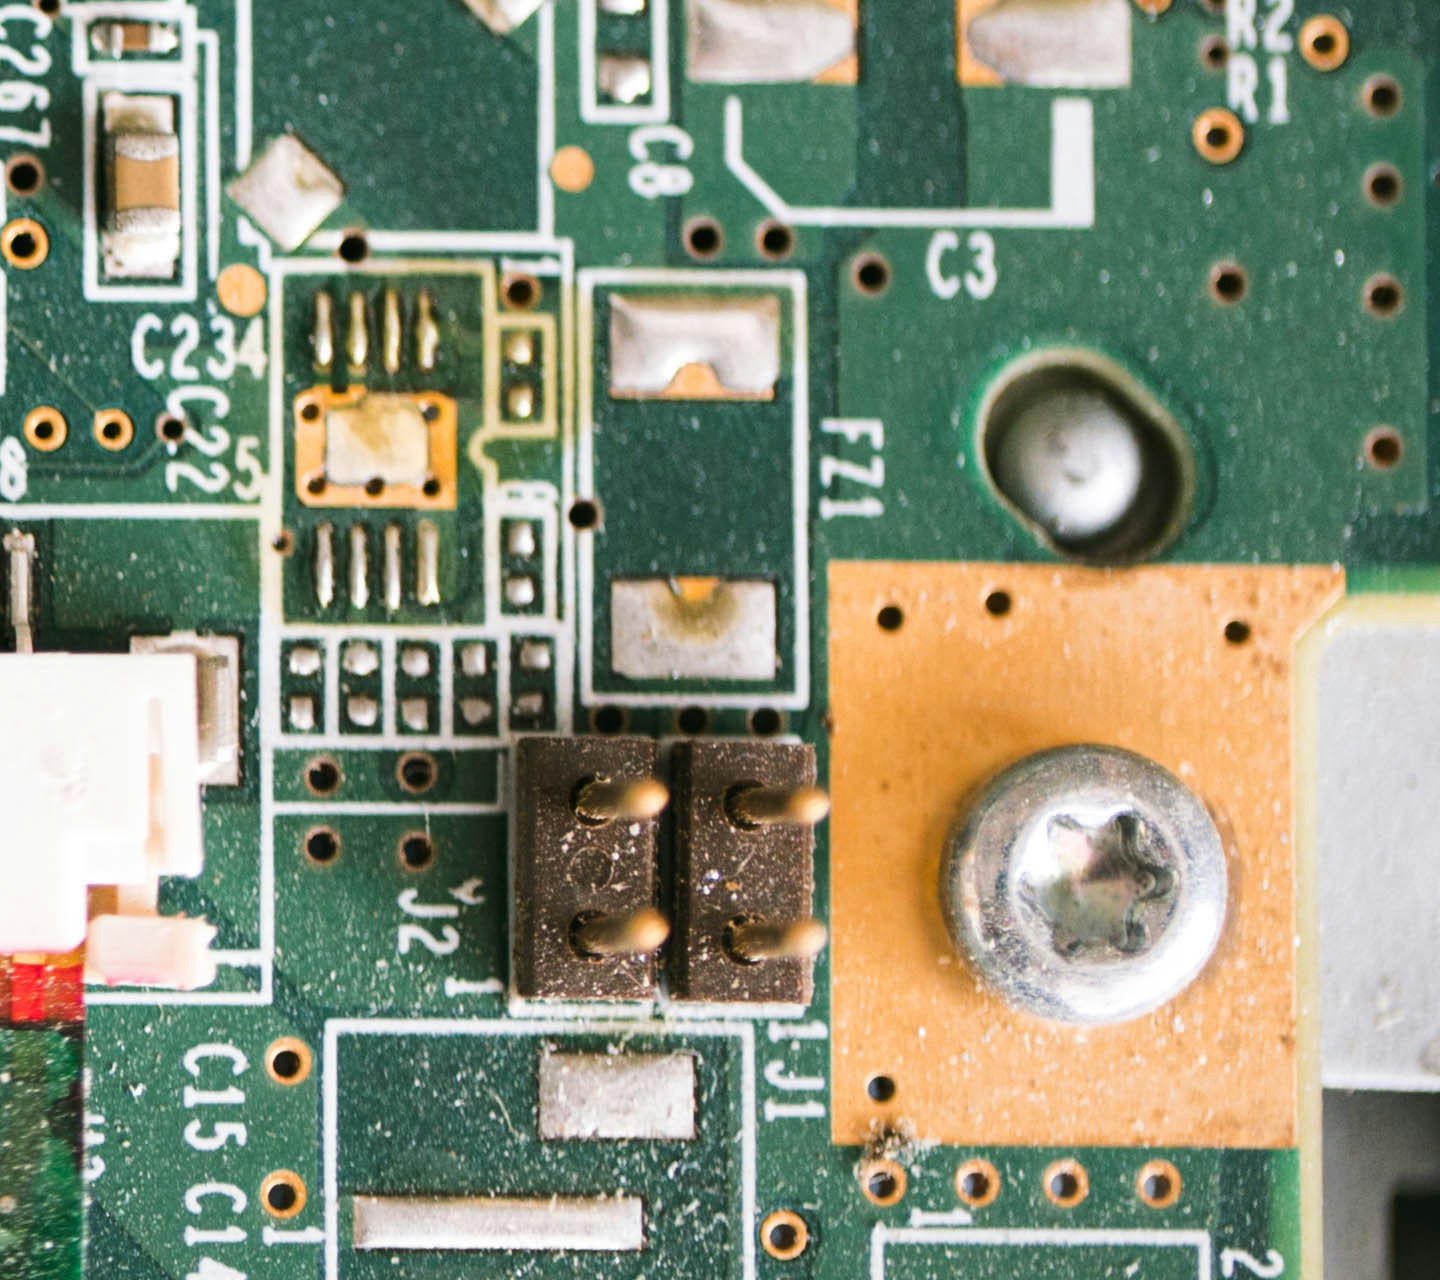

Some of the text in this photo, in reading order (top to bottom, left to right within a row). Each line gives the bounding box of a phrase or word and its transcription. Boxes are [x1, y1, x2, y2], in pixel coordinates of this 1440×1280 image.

[1226, 53, 1289, 123] R1
[628, 126, 693, 199] C8
[926, 230, 998, 300] C3
[131, 314, 268, 379] C234
[821, 417, 884, 519] FZ1
[399, 889, 459, 954] J2
[183, 1043, 248, 1151] C15
